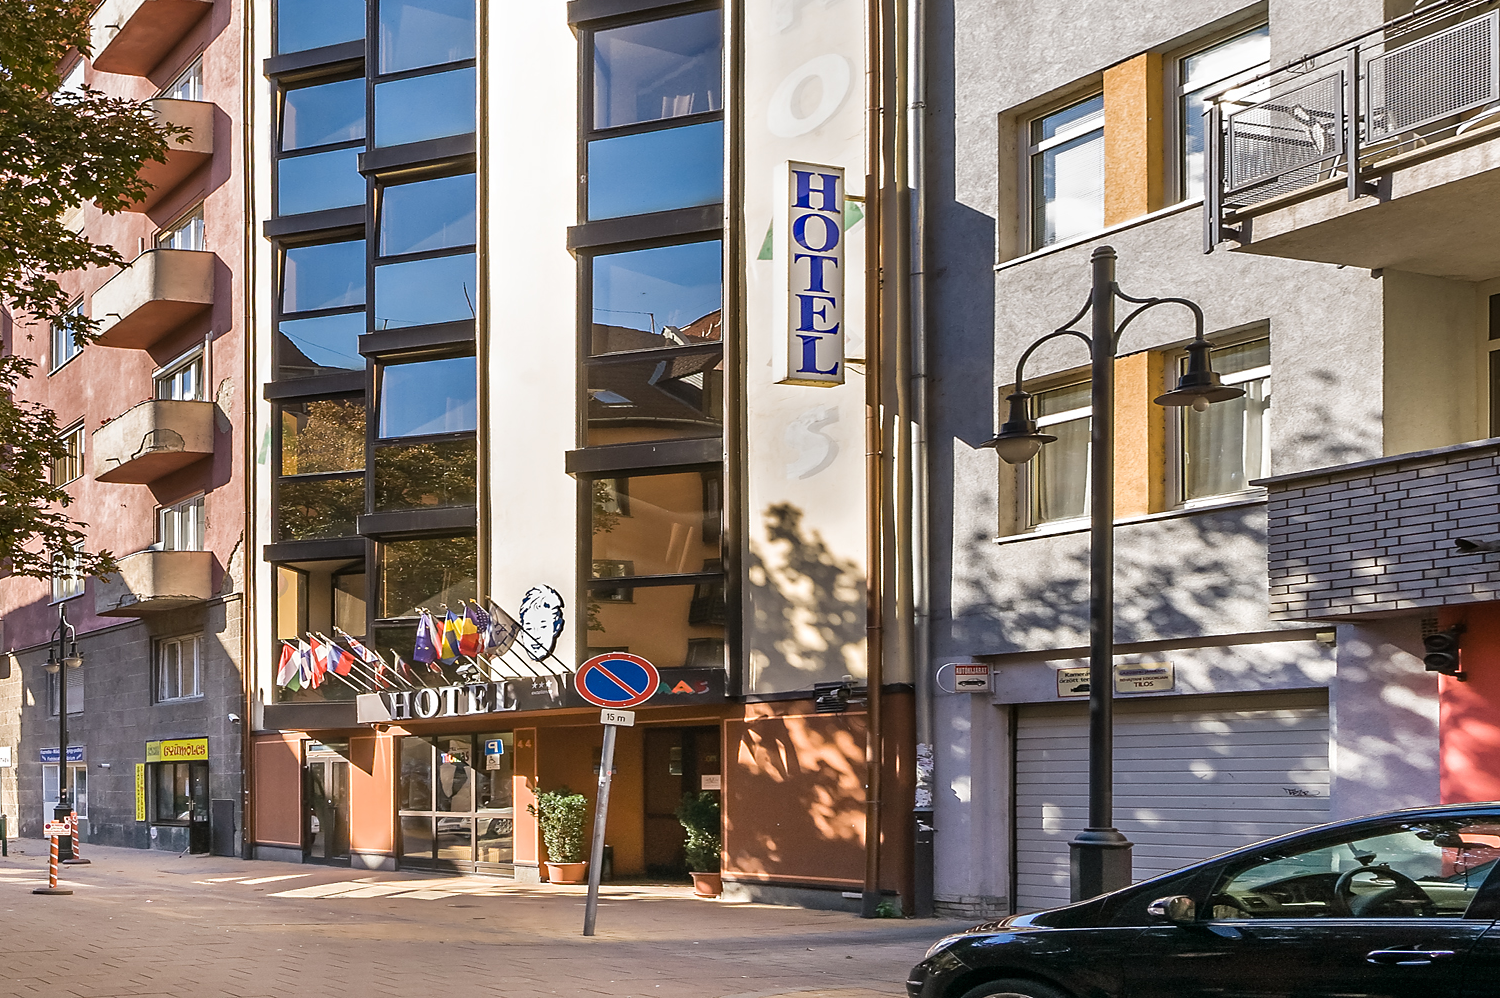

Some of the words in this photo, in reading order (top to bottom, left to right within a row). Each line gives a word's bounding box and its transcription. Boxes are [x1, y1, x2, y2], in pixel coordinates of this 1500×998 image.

[791, 170, 841, 376] HOTEL
[388, 681, 517, 721] HOTEL
[606, 713, 615, 722] 15
[617, 715, 626, 723] m
[517, 739, 532, 749] 44
